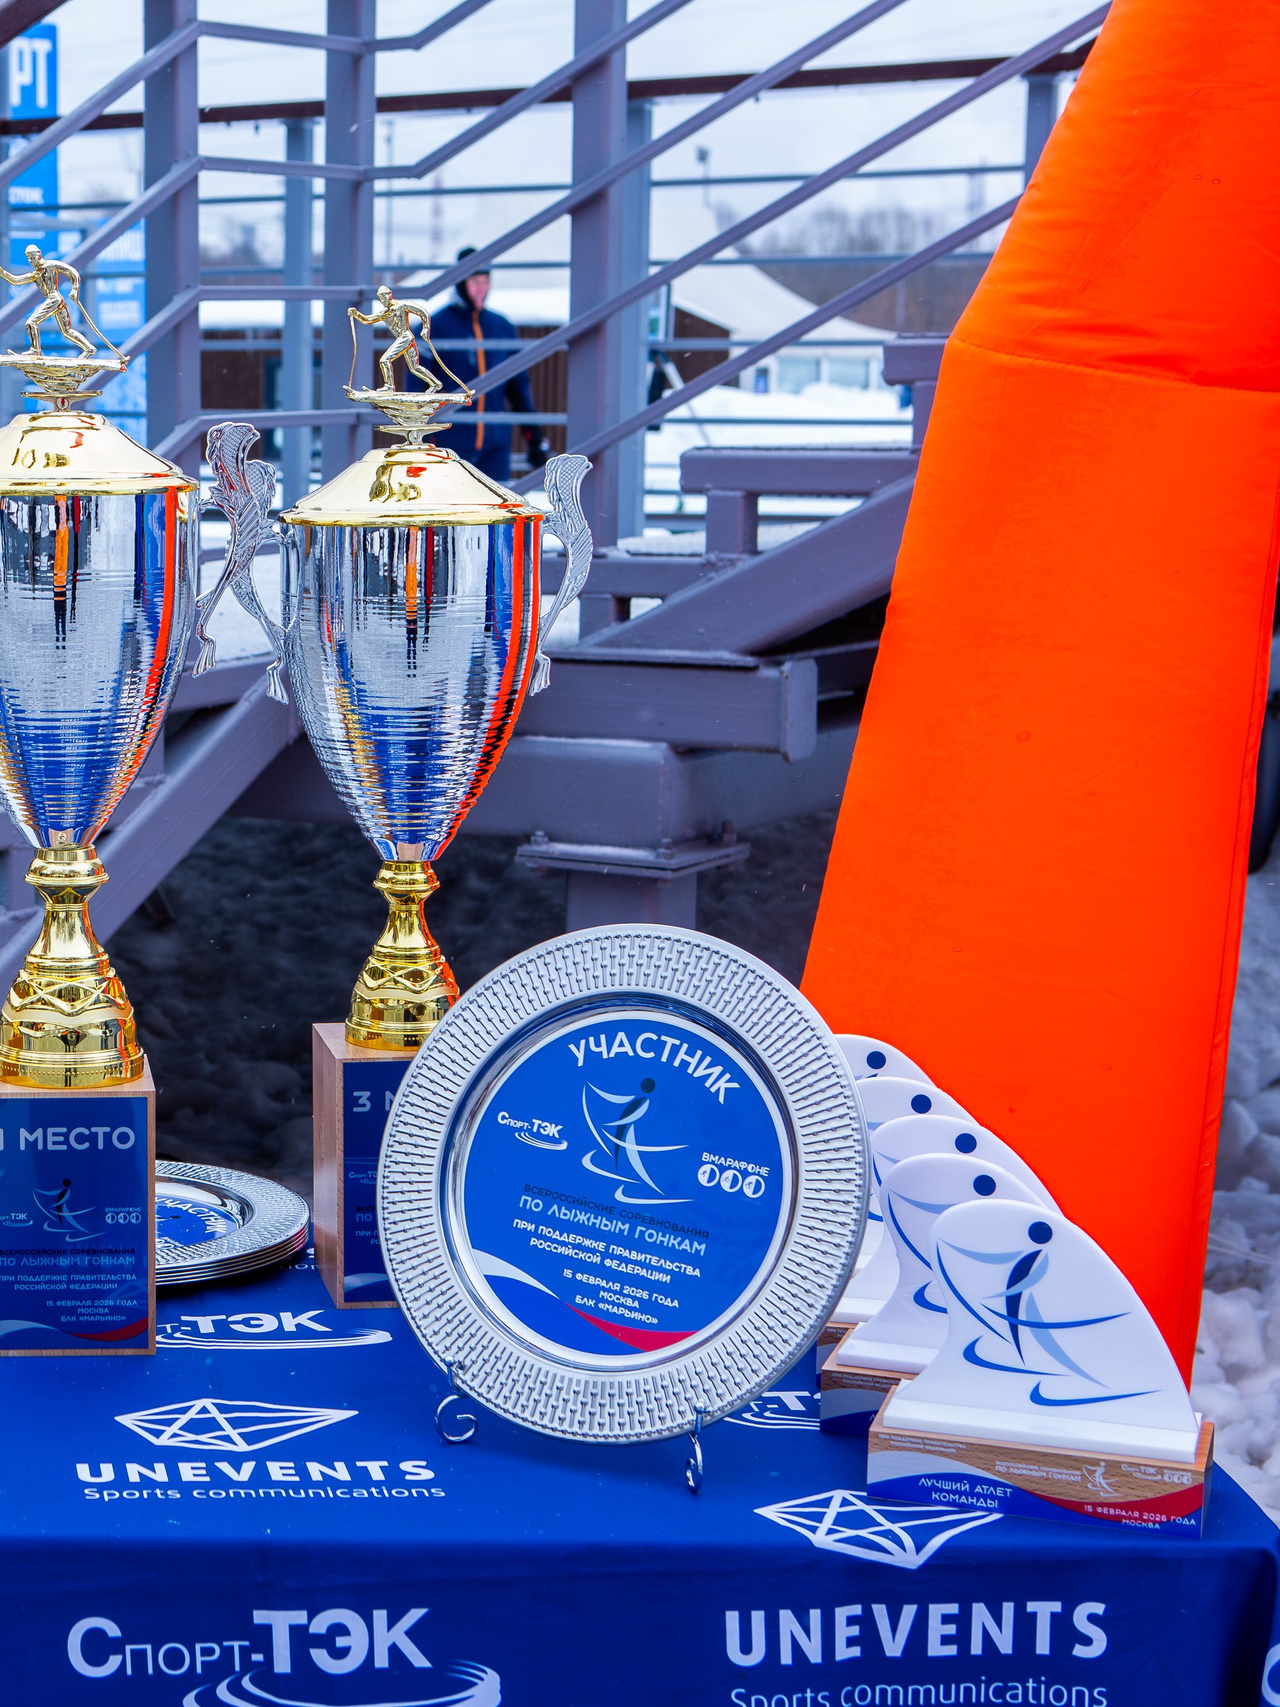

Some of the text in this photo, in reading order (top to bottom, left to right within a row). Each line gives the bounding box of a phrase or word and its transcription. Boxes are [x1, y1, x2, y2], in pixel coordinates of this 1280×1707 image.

[567, 1031, 741, 1105] УЧАСТНИК
[353, 1091, 371, 1112] 3
[20, 1126, 136, 1151] МЕСТО
[356, 1213, 373, 1222] ПО
[524, 1183, 710, 1240] ВСЕРОССИЙСКИЕ СОРЕВНОВАНИЯ
[519, 1195, 706, 1256] ПО ЛЫЖНЫМ ГОНКАМ
[71, 1248, 136, 1256] СОРЕВНОВАНИЯ
[513, 1218, 701, 1278] ПРИ ПОДДЕРЖКЕ ПРАВИТЕЛЬСТВА
[0, 1255, 136, 1267] ПО ЛЫЖНЫМ ГОНКАМ
[529, 1238, 671, 1284] РОССИЙСКОЙ ФЕДЕРАЦИИ
[14, 1282, 118, 1291] РОССИЙСКОЙ ФЕДЕРАЦИИ
[18, 1274, 68, 1282] ПОДДЕРЖКЕ
[563, 1268, 679, 1309] 15 ФЕВРАЛЯ 2026 ГОДА
[575, 1296, 659, 1325] БЛК «МАРЬИНО»
[599, 1290, 639, 1309] МОСКВА
[76, 1460, 436, 1483] UNEVENTS
[84, 1484, 446, 1502] Sports communications
[918, 1477, 1013, 1498] ЛУЧШИЙ АТЛЕТ
[931, 1491, 998, 1508] КОМАНДЫ
[1084, 1504, 1196, 1526] 15 ФЕВРАЛЯ 2026 ГОДА
[1122, 1518, 1161, 1530] МОСКВА
[725, 1601, 1108, 1666] UNEVENTS
[730, 1676, 1108, 1707] Sports communications
